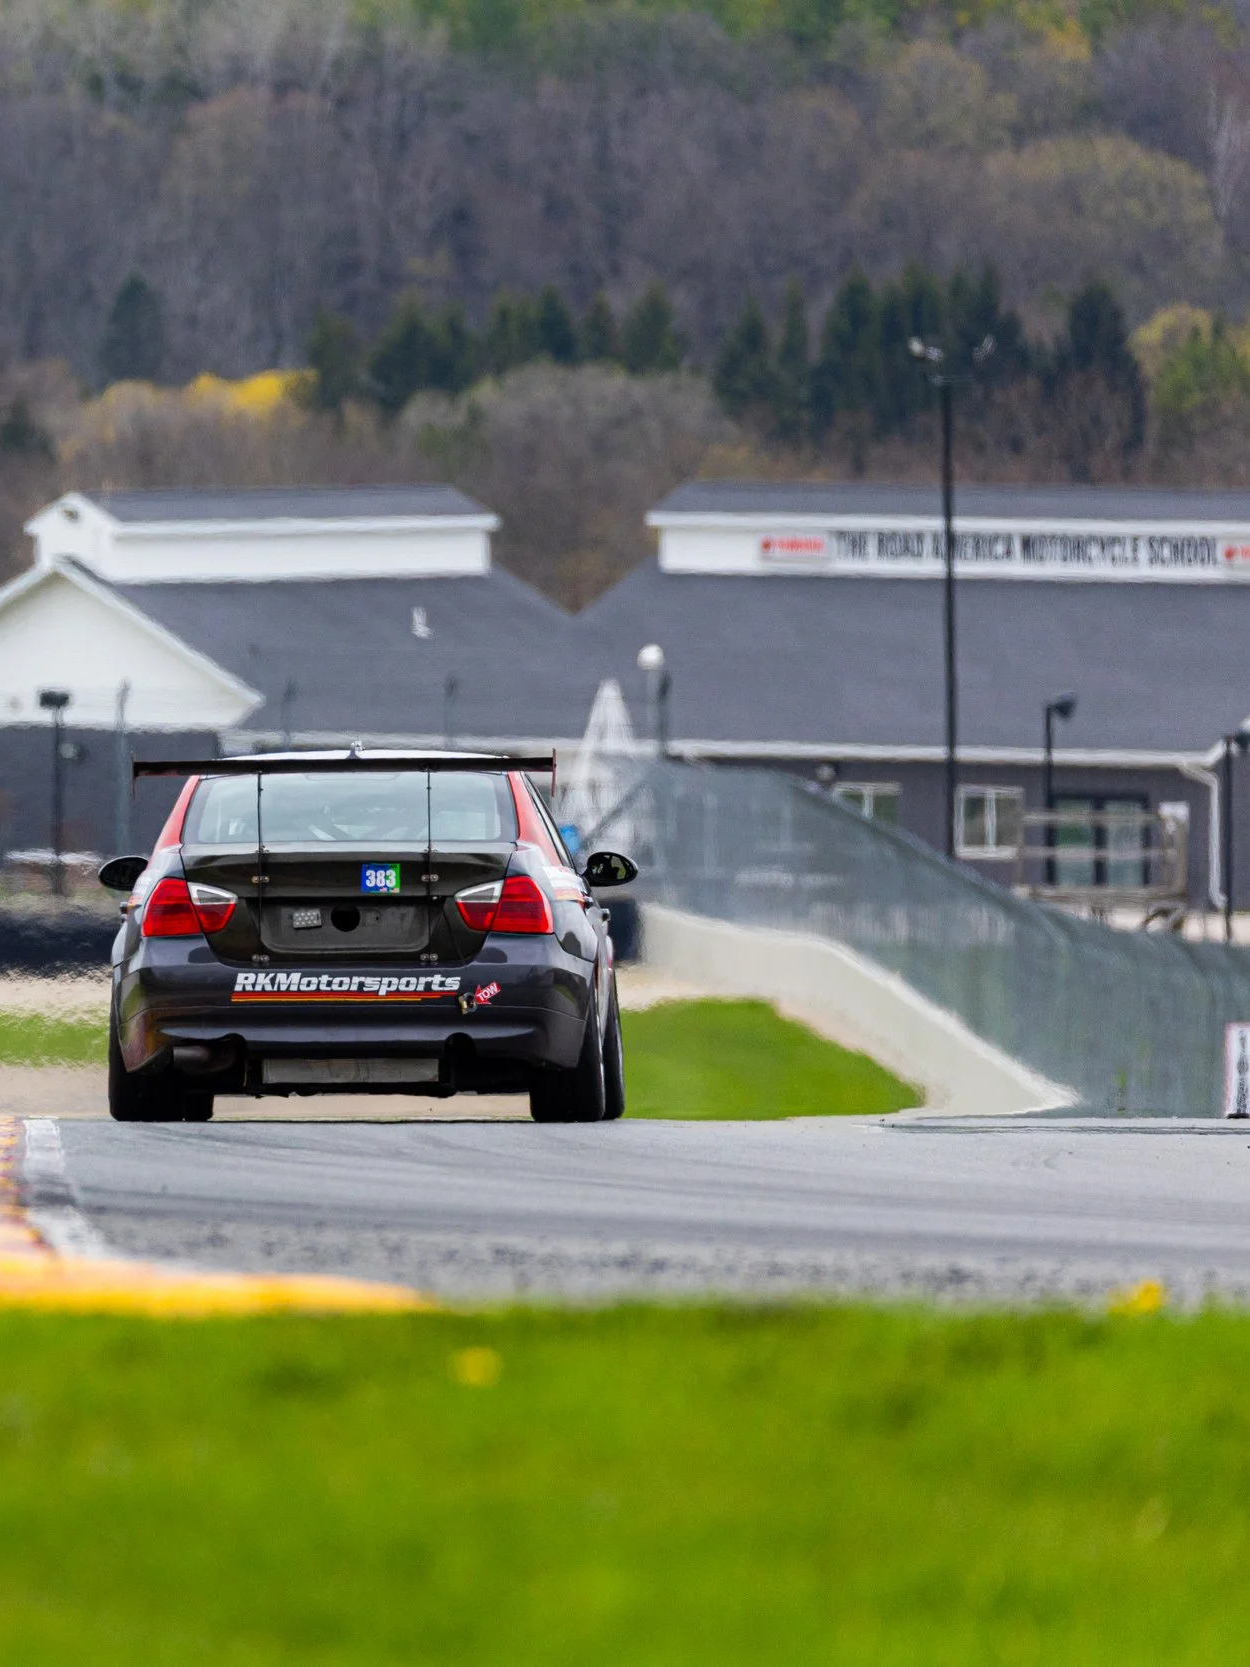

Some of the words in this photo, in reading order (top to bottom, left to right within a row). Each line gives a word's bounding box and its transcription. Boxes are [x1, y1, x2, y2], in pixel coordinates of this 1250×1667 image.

[836, 530, 868, 560] THE
[877, 531, 925, 560] ROAD
[1021, 534, 1139, 564] MOTORCYCLE
[1148, 536, 1217, 566] SCHOOL
[366, 870, 396, 887] 383
[234, 972, 461, 995] RKMotorsports
[476, 982, 498, 1001] TOW
